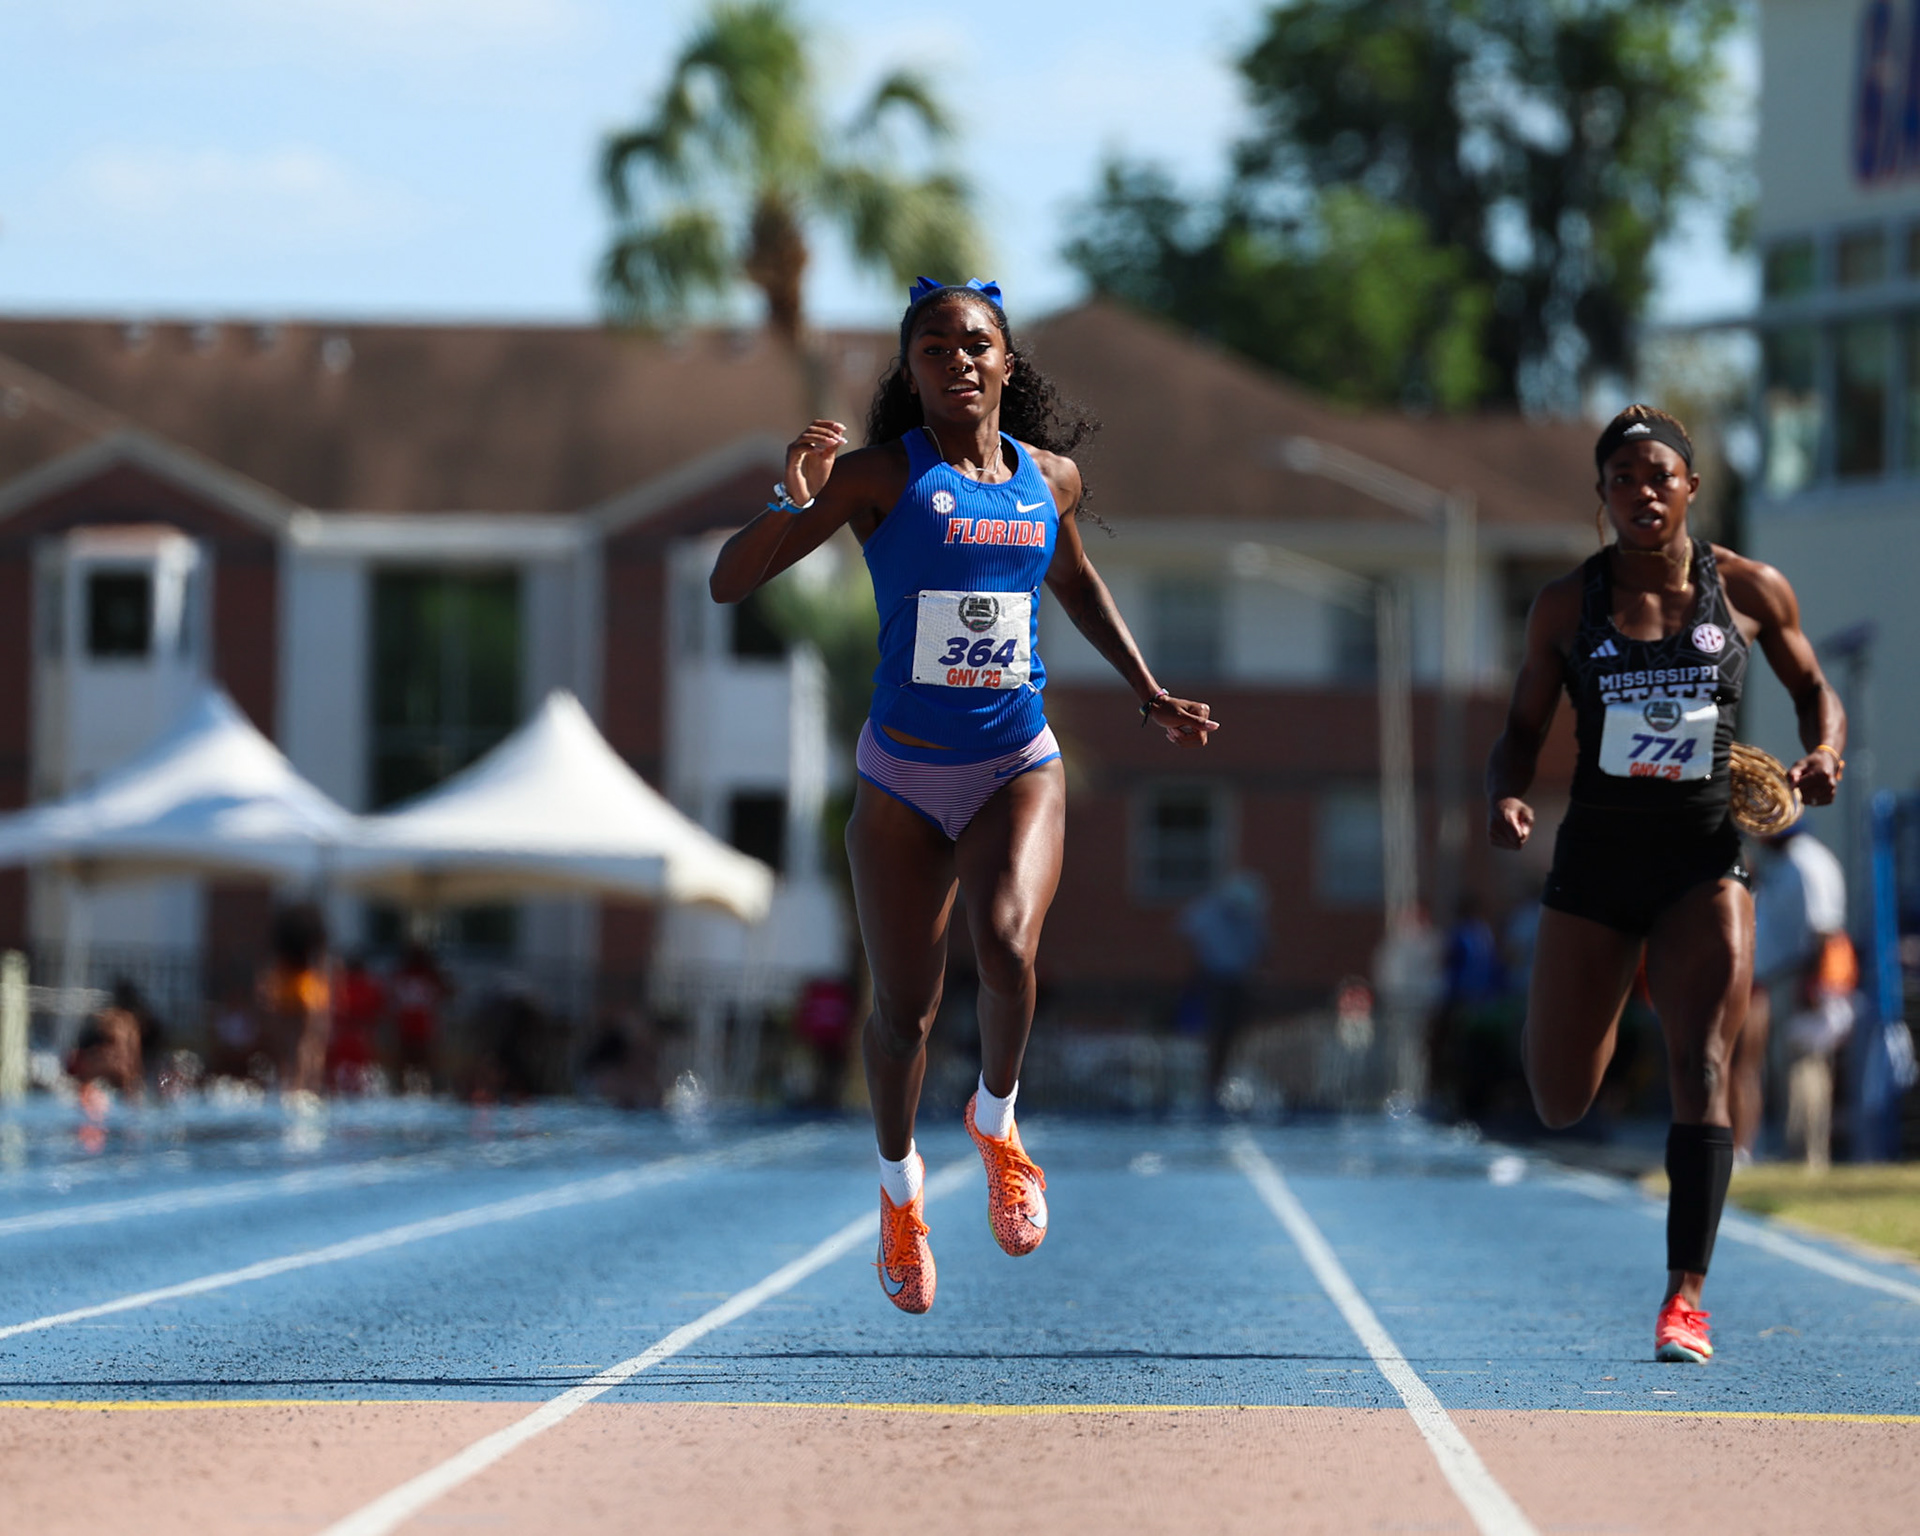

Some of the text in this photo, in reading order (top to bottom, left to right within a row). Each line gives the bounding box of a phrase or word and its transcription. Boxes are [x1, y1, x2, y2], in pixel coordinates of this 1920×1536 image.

[944, 517, 1046, 548] FLORIDA
[938, 636, 1018, 668] 364
[946, 668, 980, 686] GNV
[1598, 665, 1719, 692] MISSISSIPPI
[1627, 733, 1697, 763] 774
